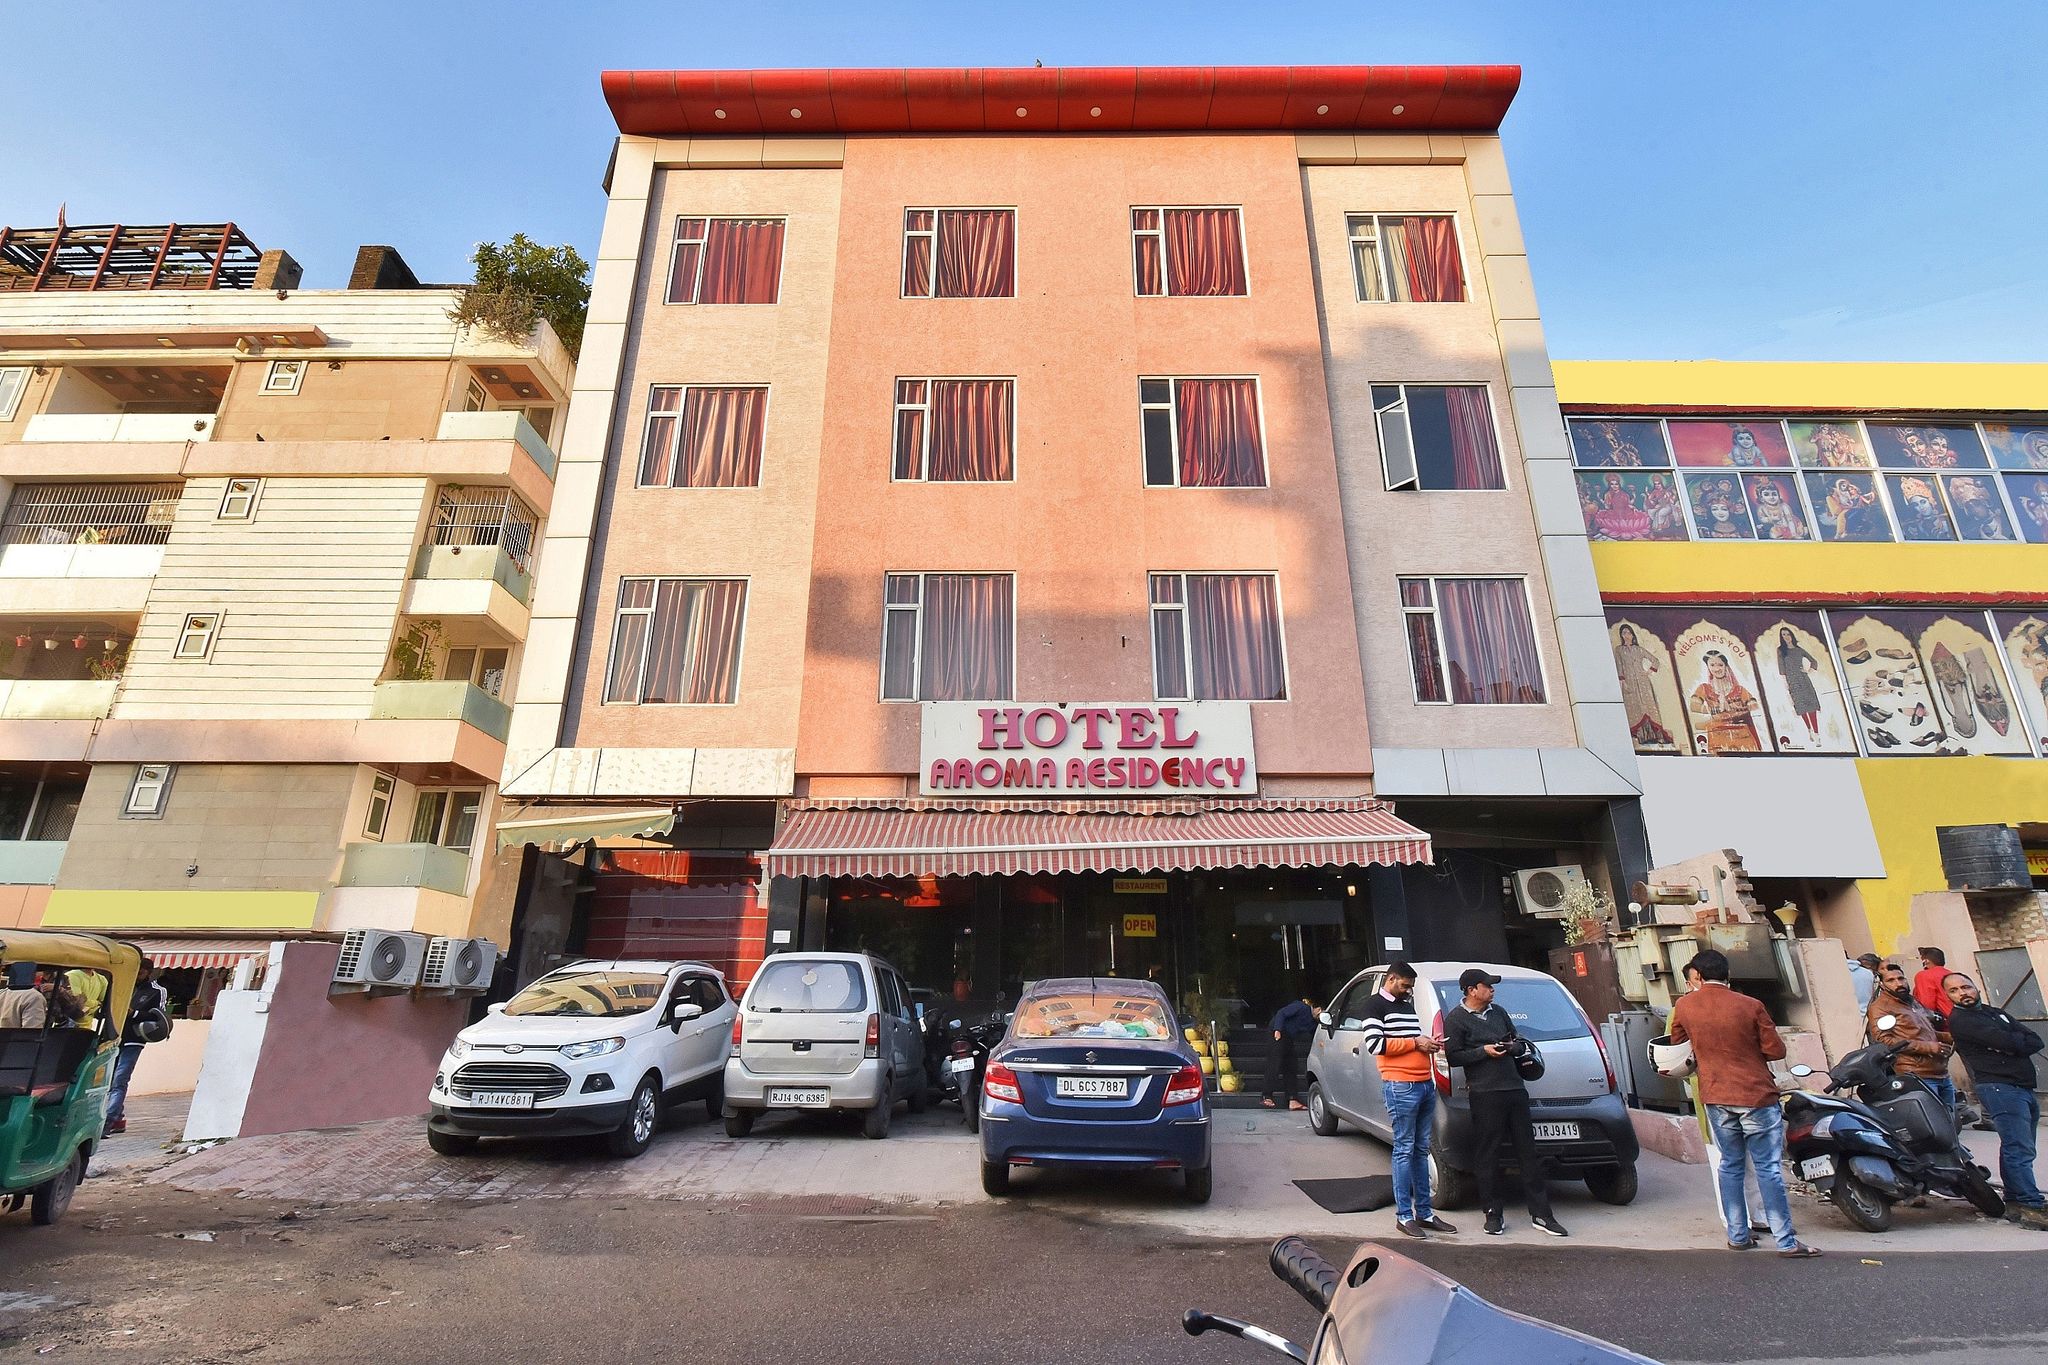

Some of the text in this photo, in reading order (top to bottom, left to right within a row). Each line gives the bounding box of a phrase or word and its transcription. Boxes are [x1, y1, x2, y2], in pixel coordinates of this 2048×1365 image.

[1679, 635, 1745, 658] WELCOME'S YOU
[977, 707, 1199, 749] HOTEL
[930, 757, 1245, 788] AROMA RESIDENCY
[1124, 919, 1155, 932] OPEN
[1063, 1080, 1125, 1093] DL 6CS 7887
[772, 1093, 826, 1103] RJ14 9C 6385
